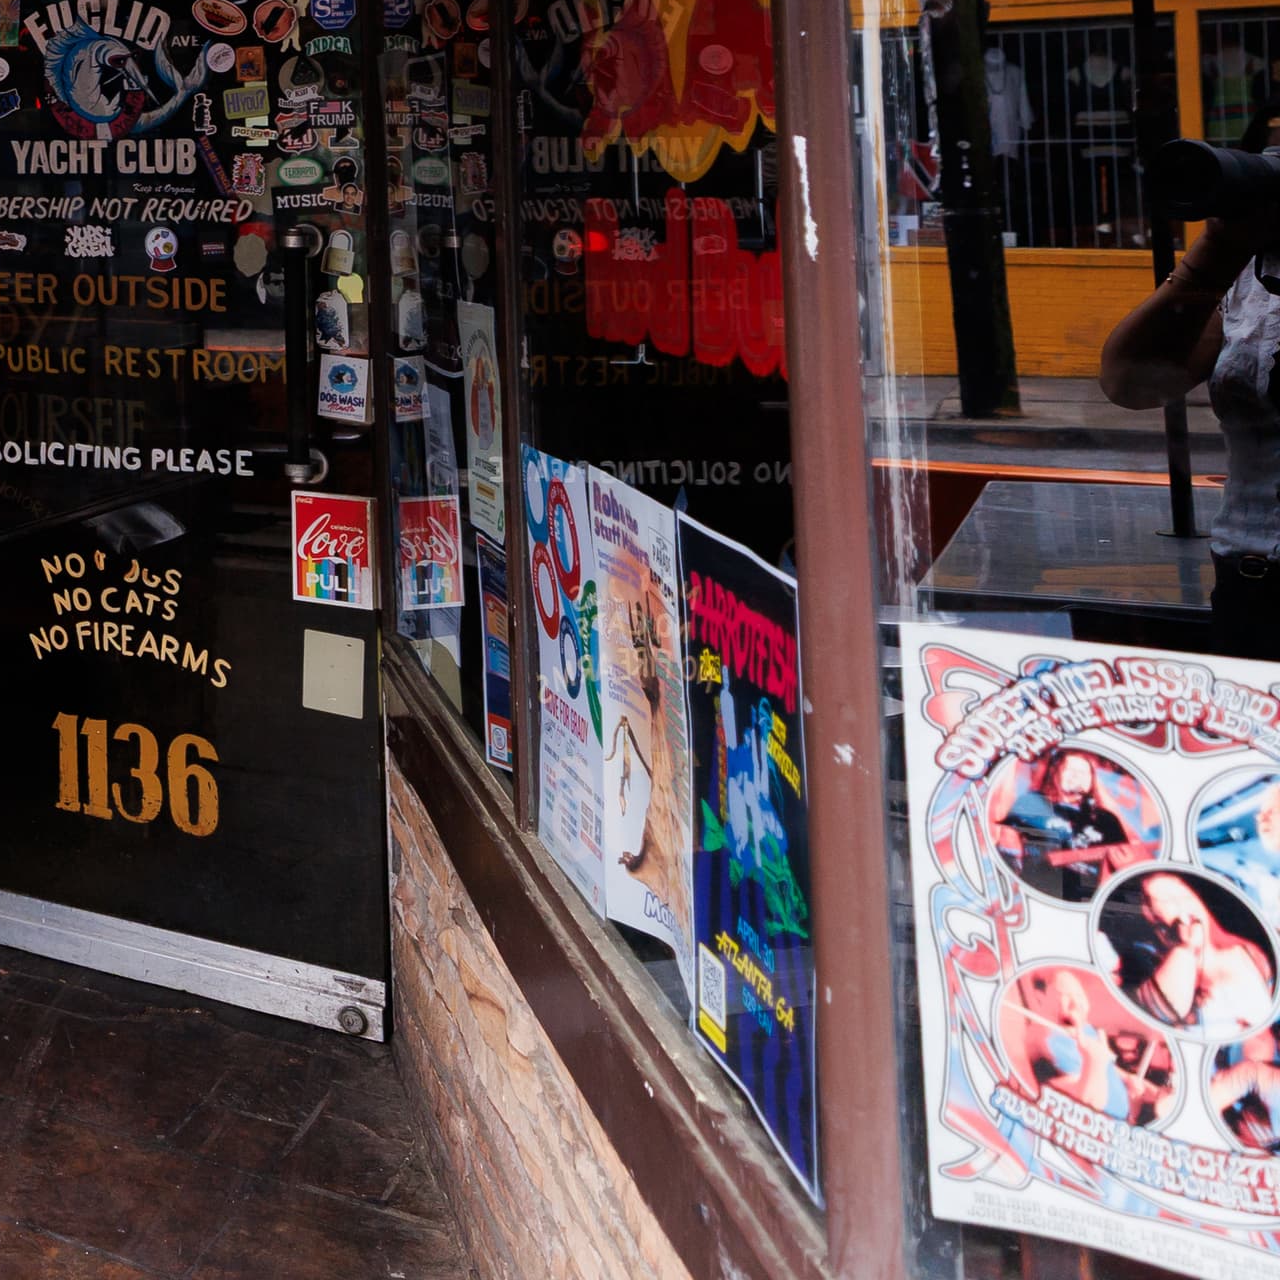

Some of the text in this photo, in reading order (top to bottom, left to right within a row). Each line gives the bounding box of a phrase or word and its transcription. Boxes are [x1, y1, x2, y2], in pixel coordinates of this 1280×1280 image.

[309, 113, 355, 126] TRUMP
[11, 139, 108, 175] YACHT
[116, 137, 197, 176] CLUB
[90, 197, 139, 221] NOT
[141, 197, 253, 223] REQUIRED
[72, 273, 227, 312] OUTSIDE
[320, 392, 365, 408] DOG WASH
[151, 447, 254, 476] PLEASE
[593, 480, 619, 523] Rob
[41, 552, 86, 584] NO
[306, 572, 360, 594] PULL
[53, 586, 179, 621] NO CATS
[29, 621, 232, 688] NO FIREARMS
[1040, 658, 1210, 708] MELISSA
[1059, 700, 1101, 734] THE
[1102, 696, 1168, 723] MUSIC
[1170, 699, 1203, 724] OF
[51, 711, 220, 837] 1136
[737, 916, 761, 960] APRIL
